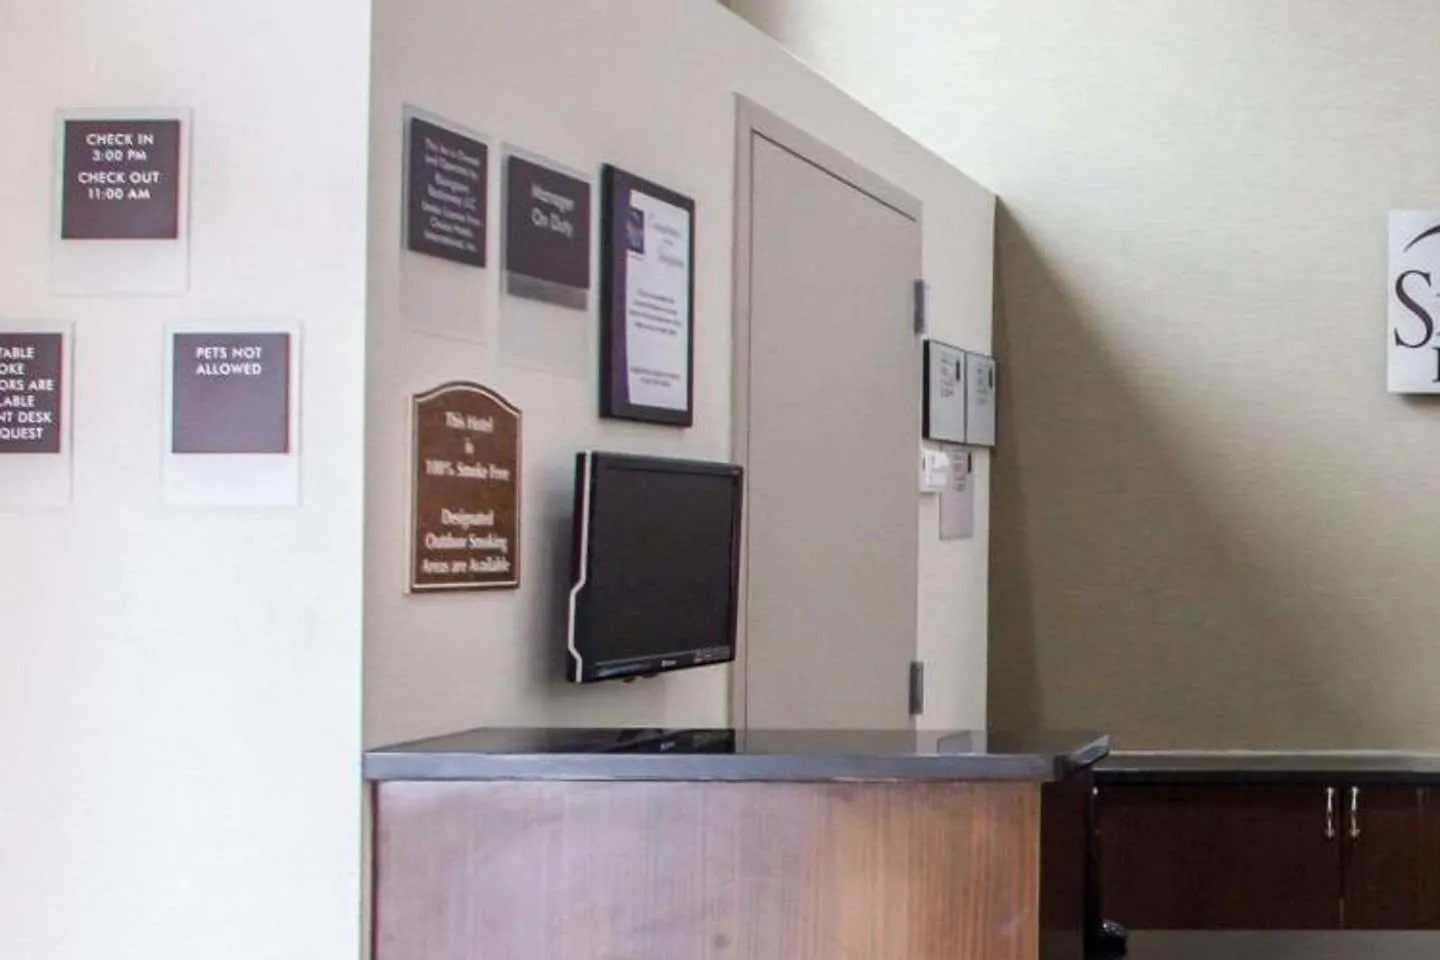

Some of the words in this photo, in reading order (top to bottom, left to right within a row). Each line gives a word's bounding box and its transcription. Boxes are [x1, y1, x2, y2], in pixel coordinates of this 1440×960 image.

[85, 132, 134, 145] CHECK
[137, 133, 154, 145] IN
[91, 149, 124, 161] 3:00
[127, 149, 147, 161] PM
[78, 171, 126, 184] CHECK
[129, 171, 160, 184] OUT
[88, 187, 124, 200] 11:00
[127, 188, 151, 199] AM
[195, 346, 227, 359] PETS
[231, 346, 262, 359] NOT
[195, 362, 262, 376] ALLOWED
[28, 379, 54, 391] ARE
[18, 411, 52, 423] DESK
